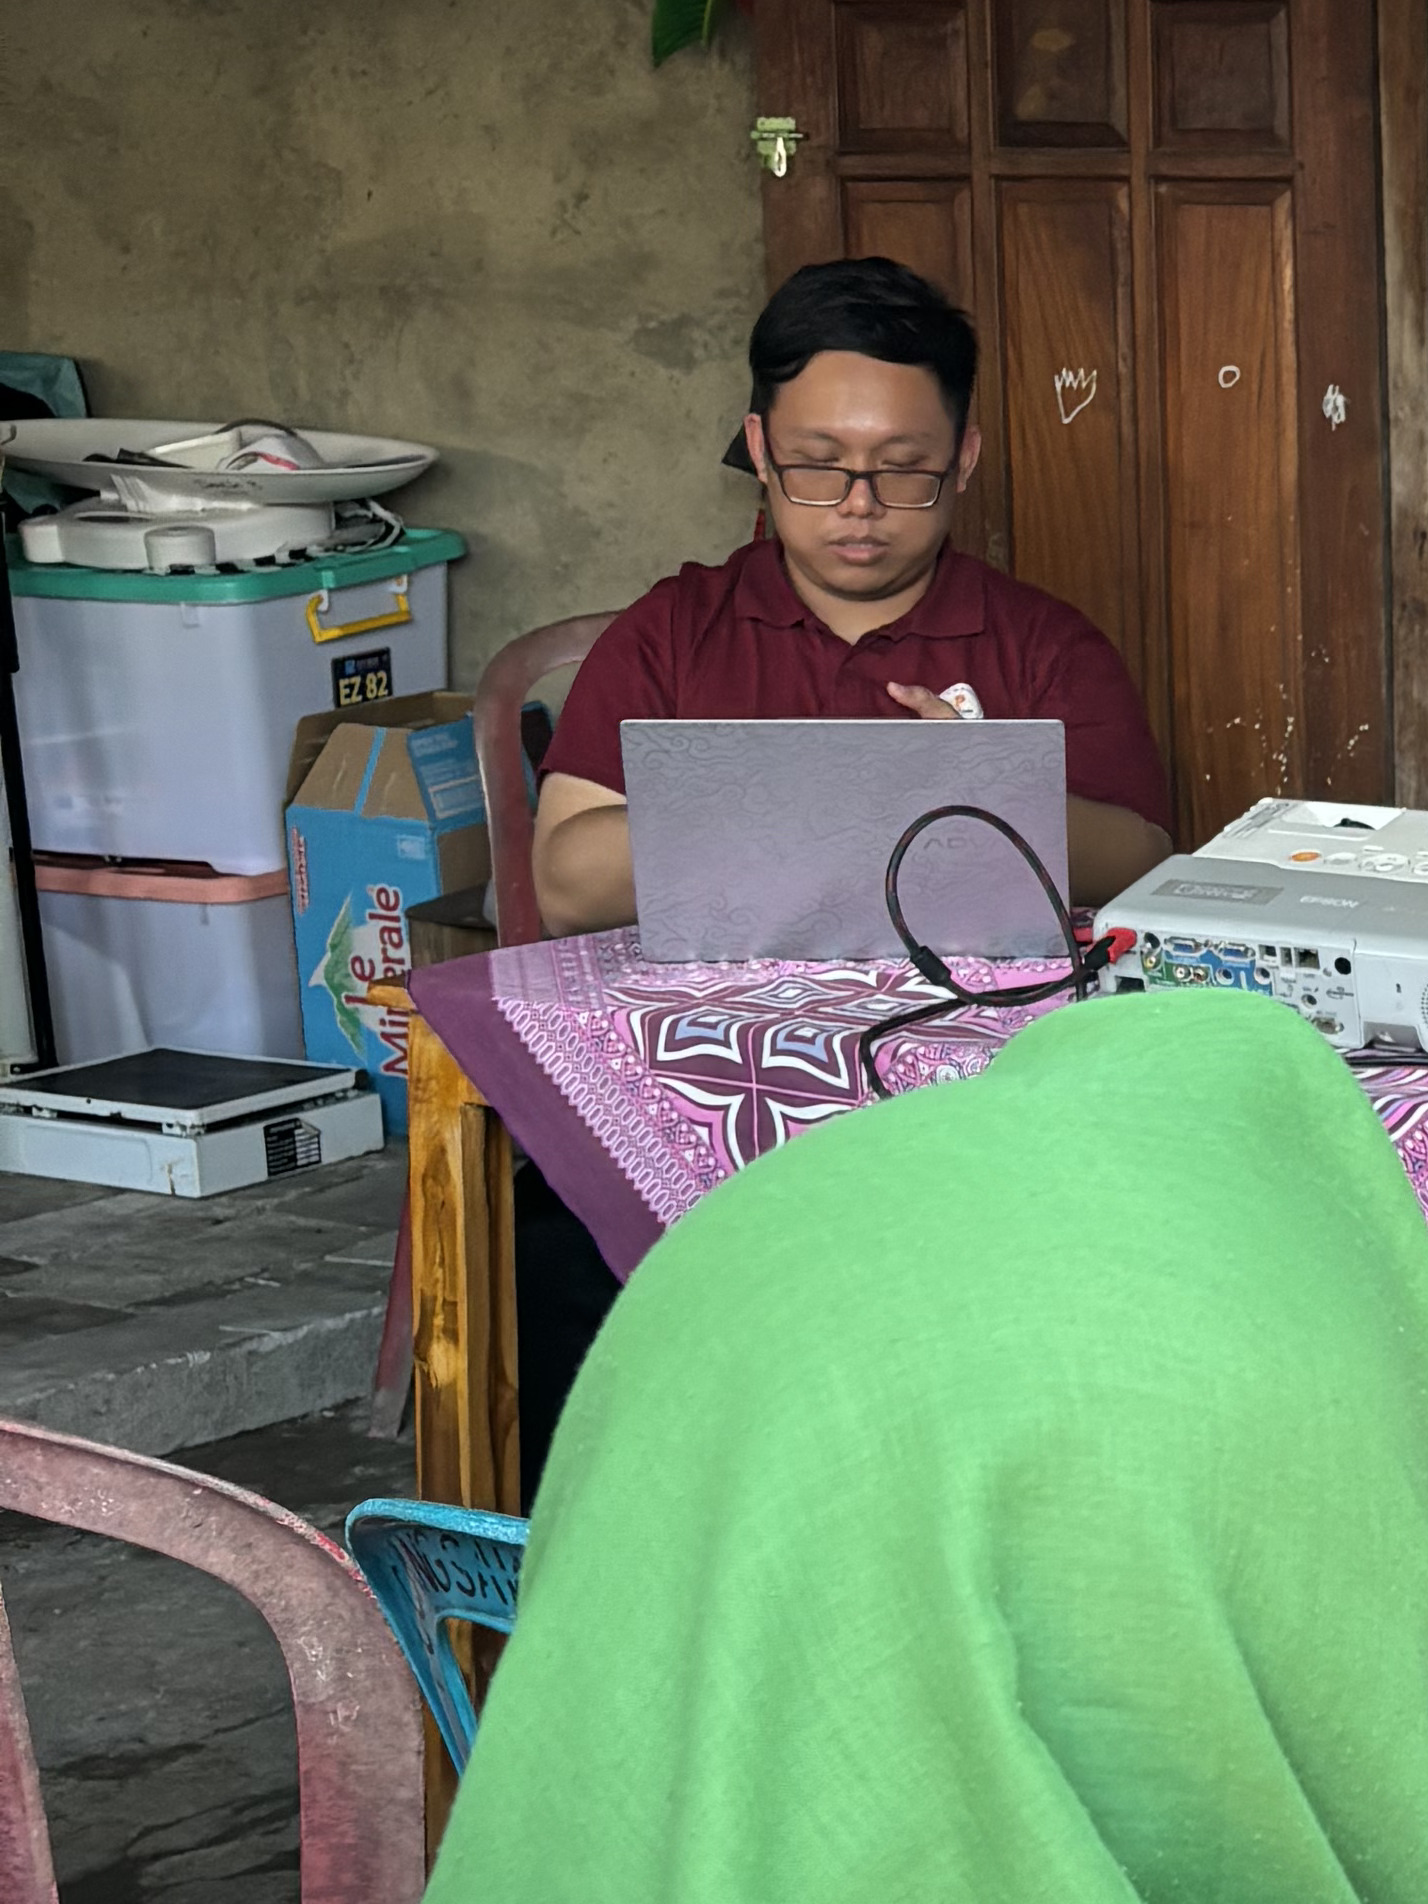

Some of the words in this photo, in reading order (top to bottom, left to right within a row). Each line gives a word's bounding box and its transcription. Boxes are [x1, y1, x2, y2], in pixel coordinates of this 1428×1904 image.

[338, 675, 363, 706] EZ
[365, 669, 389, 700] 82
[1299, 895, 1360, 909] EPSON
